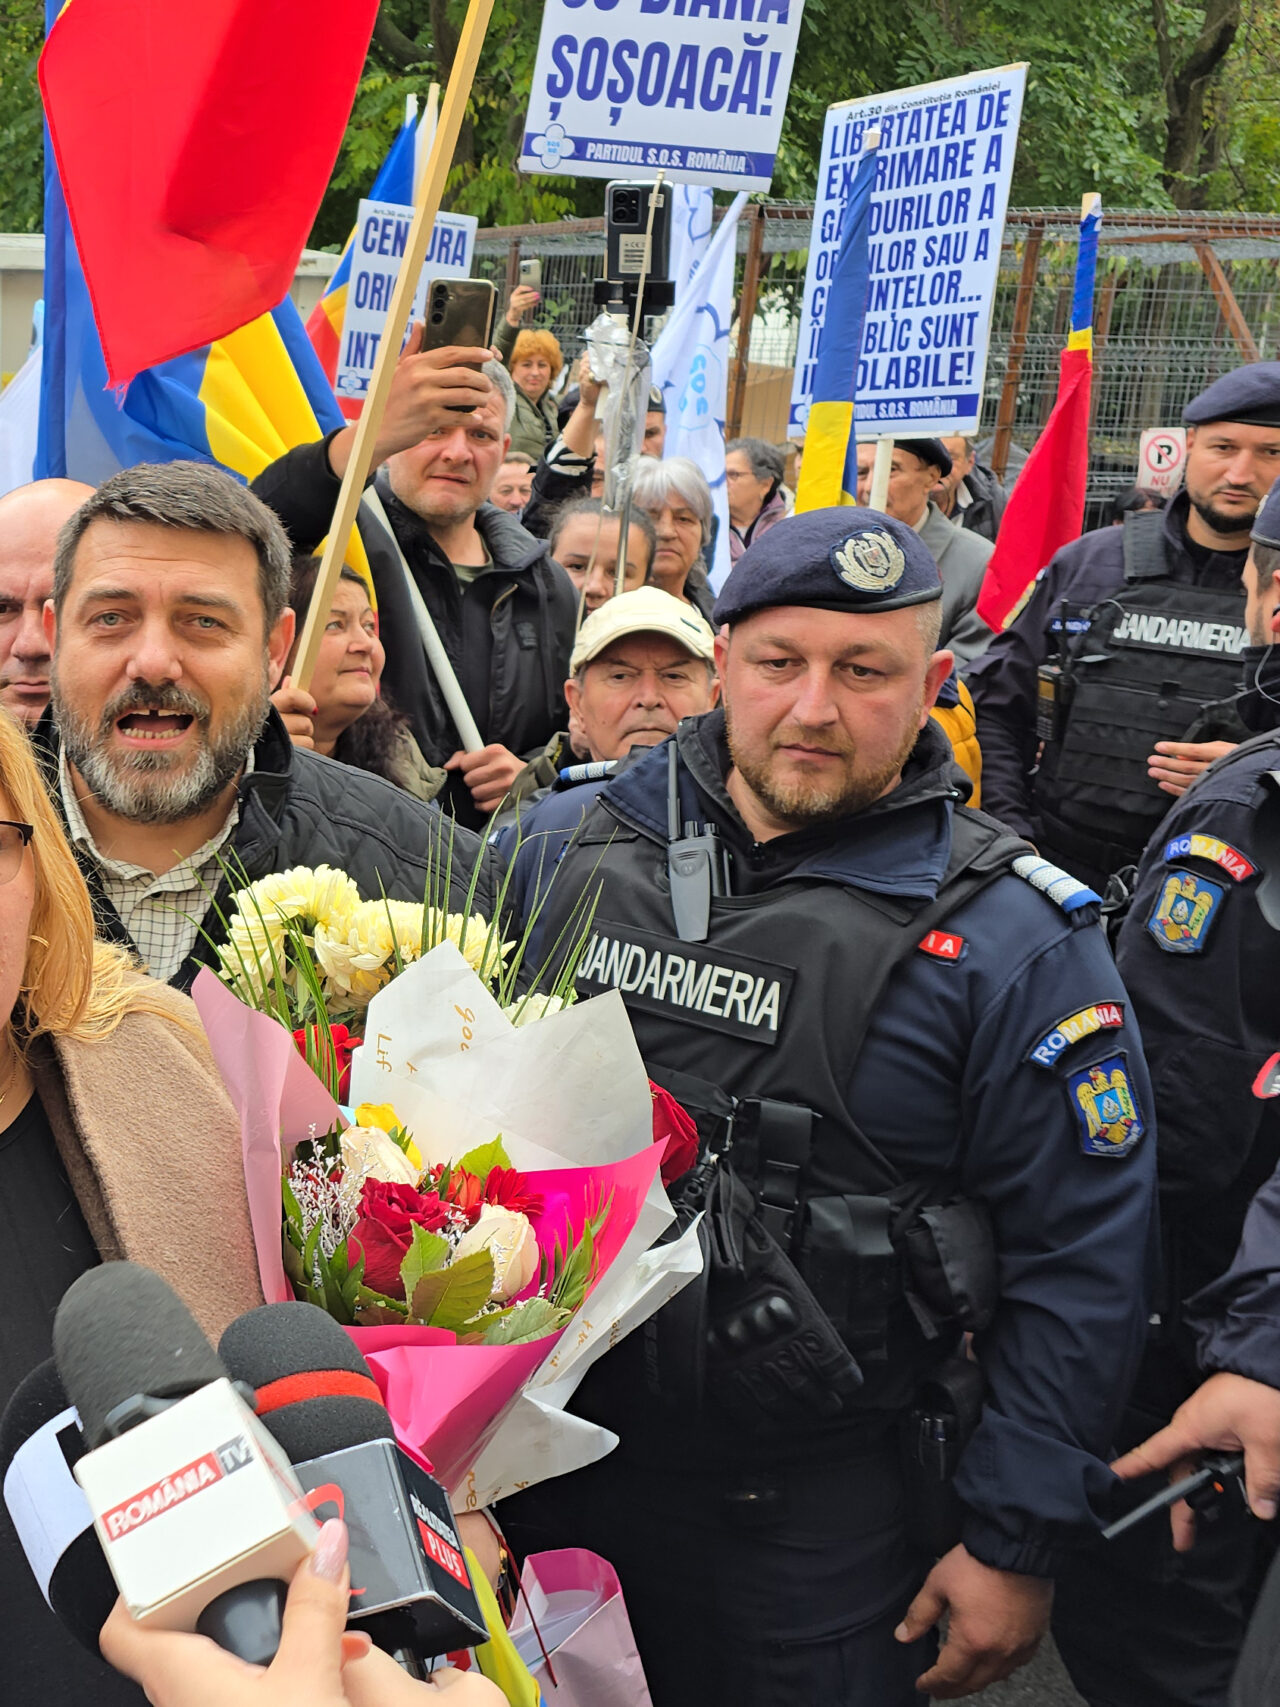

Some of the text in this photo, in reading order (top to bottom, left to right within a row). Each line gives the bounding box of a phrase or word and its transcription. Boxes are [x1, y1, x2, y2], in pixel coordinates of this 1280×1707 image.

[546, 32, 782, 127] ȘOȘOACĂ!
[975, 89, 1012, 132] DE
[585, 142, 746, 173] PARTIDUL S.O.S. ROMÂNIA
[825, 133, 1003, 201] EXRIMARE A
[821, 182, 996, 244] GDURILOR A
[362, 216, 468, 267] CENURA
[923, 231, 969, 268] SAU
[973, 228, 990, 262] A
[864, 319, 911, 355] BLIC
[918, 311, 980, 350] SUNT
[1114, 612, 1252, 655] JANDARMERIA
[577, 932, 781, 1031] JANDARMERIA
[107, 1438, 252, 1540] ROMÂNIA TV
[427, 1531, 462, 1578] PLUS
